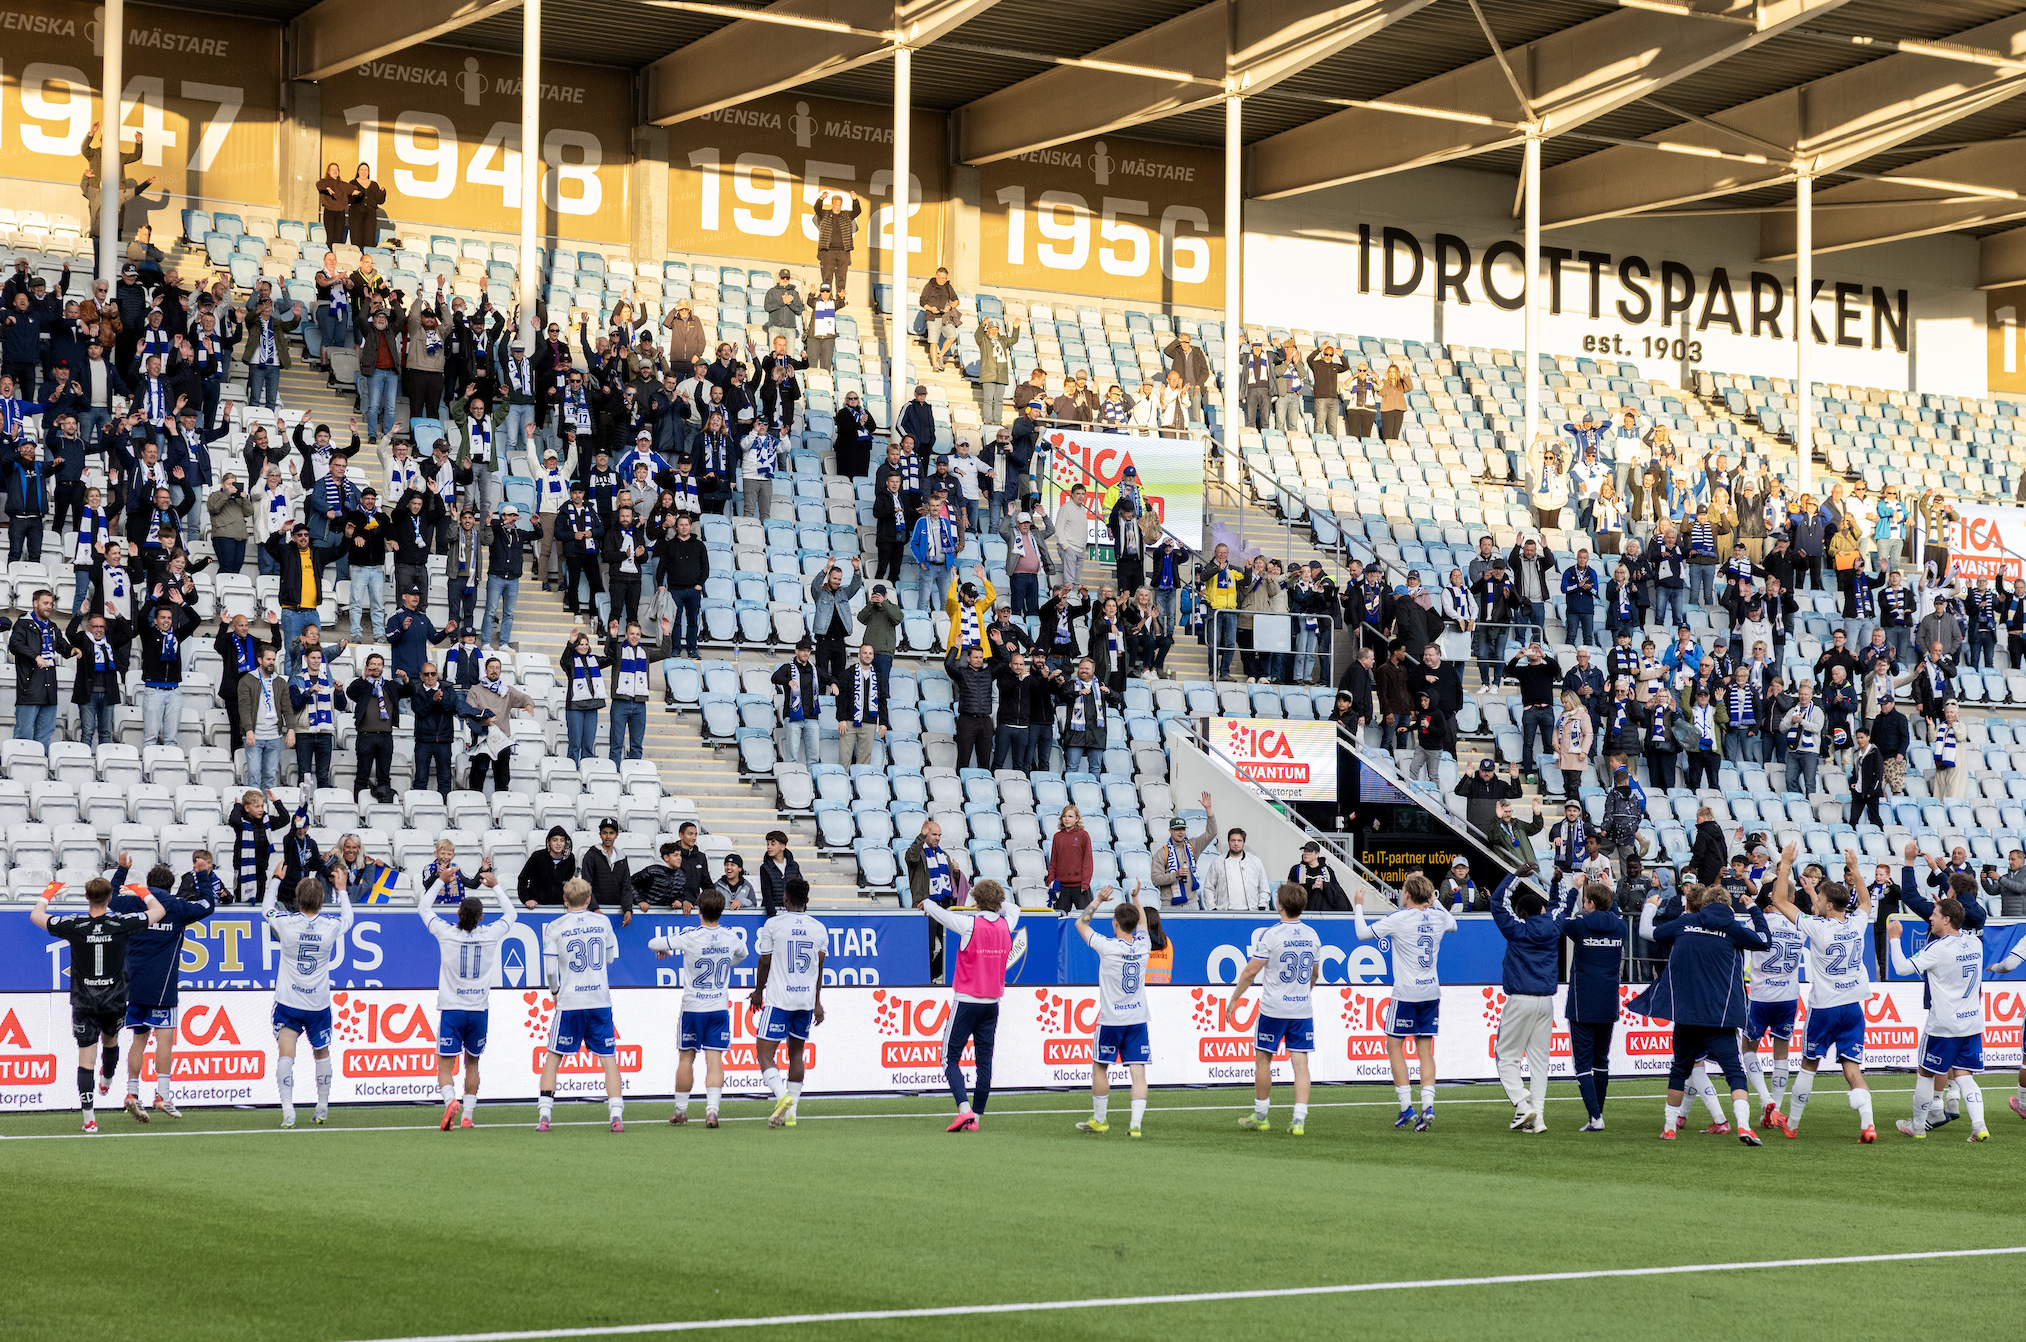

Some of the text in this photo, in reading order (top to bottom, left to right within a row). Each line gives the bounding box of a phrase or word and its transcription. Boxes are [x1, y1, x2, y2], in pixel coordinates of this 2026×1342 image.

[128, 28, 229, 57] MÄSTARE
[358, 61, 585, 103] SVENSKA MÄTARE
[0, 57, 244, 172] 947
[825, 120, 894, 144] MÄSTAR
[343, 104, 603, 216] 1948
[1121, 158, 1195, 182] MÄSTARE
[688, 147, 923, 253] 1952
[996, 185, 1210, 284] 1956
[1358, 224, 1908, 352] IDROTTSPARKEN
[1582, 332, 1703, 364] est. 1903
[1961, 516, 2007, 552] ICA
[1250, 729, 1294, 759] ICA
[1239, 766, 1306, 780] KVANTUM
[1362, 850, 1375, 864] En
[1377, 850, 1426, 866] IT-partner
[86, 934, 113, 944] KRANTZ
[299, 933, 322, 942] NYMAN
[561, 926, 605, 938] HOLST-LARSEN
[1284, 940, 1313, 948] SANDBERG
[1583, 937, 1623, 947] stadium
[94, 944, 104, 976] 1
[296, 944, 320, 975] 5
[460, 945, 481, 978] 11
[566, 937, 604, 973] 30
[701, 946, 729, 956] BRÖNNER
[787, 941, 813, 974] 15
[1417, 935, 1434, 968] 3
[1761, 941, 1803, 974] 25
[1826, 938, 1862, 976] 24
[1956, 951, 1982, 963] FRANSSON
[84, 977, 114, 986] Reztart
[693, 957, 731, 989] 20
[1122, 961, 1140, 993] 8
[1280, 951, 1314, 984] 38
[1962, 963, 1979, 998] 7
[575, 984, 601, 992] Reztart
[1283, 994, 1309, 1002] Reztart
[1834, 979, 1860, 990] Reztart
[1114, 1001, 1141, 1010] Reztart
[1864, 992, 1902, 1023] CA
[1956, 1009, 1979, 1019] Reztart
[173, 1003, 241, 1045] CA
[368, 1003, 436, 1043] ICA
[349, 1054, 438, 1072] KVANTU
[356, 1082, 440, 1096] Klockaretorpe
